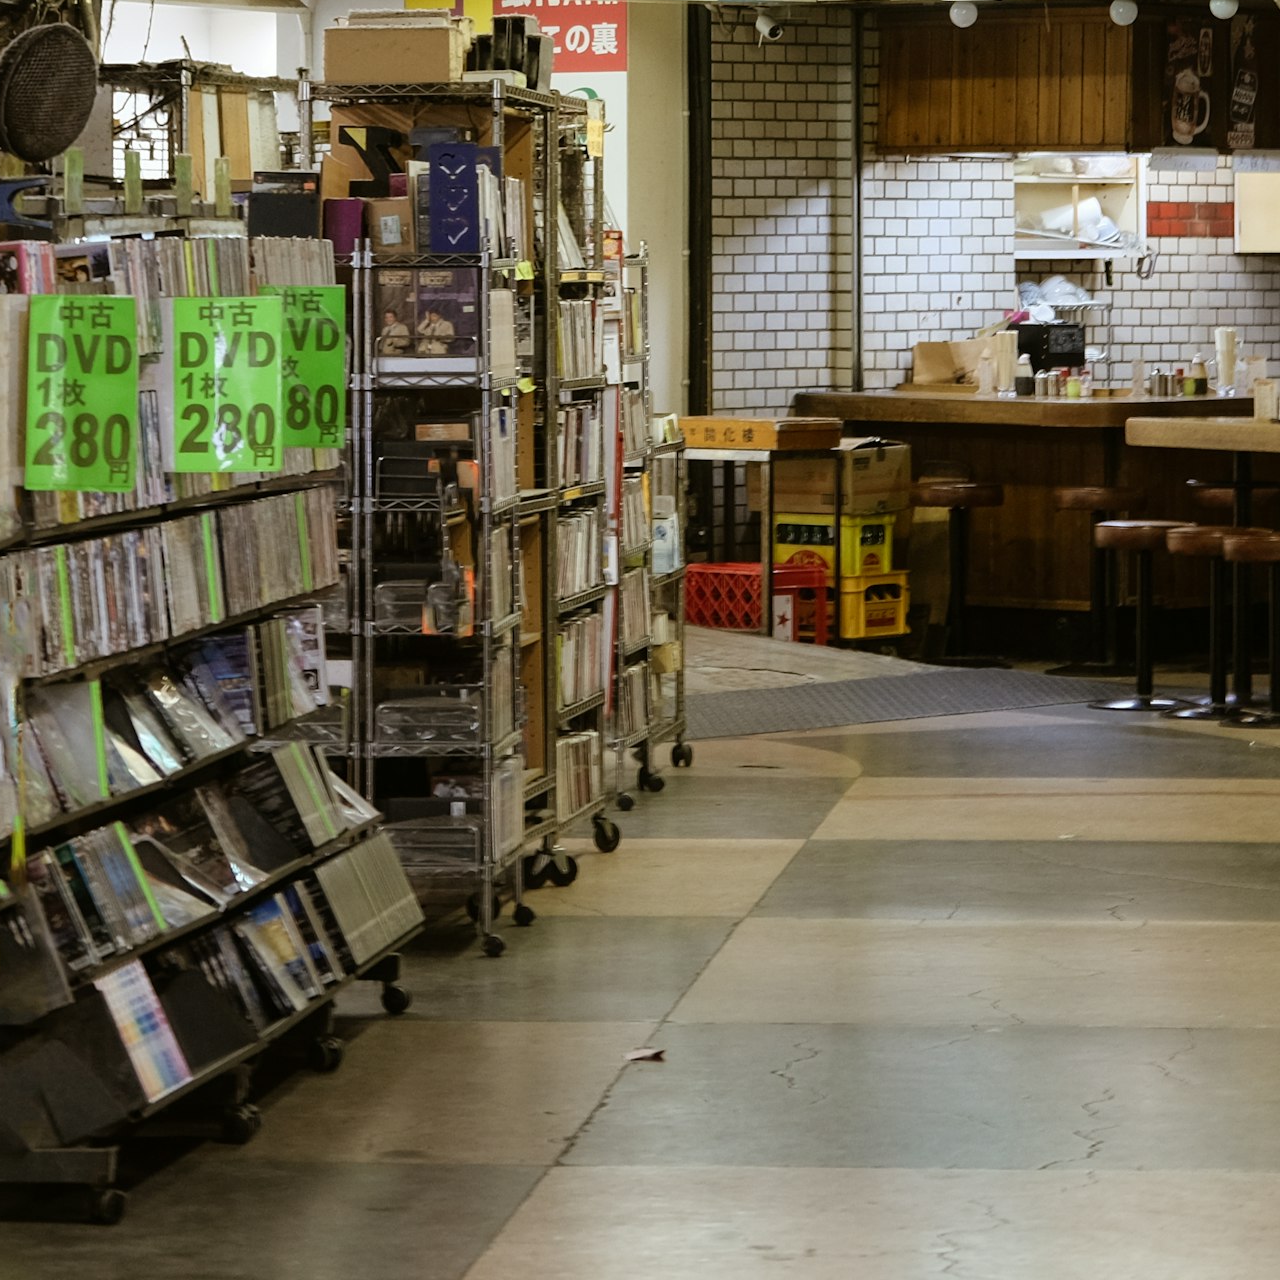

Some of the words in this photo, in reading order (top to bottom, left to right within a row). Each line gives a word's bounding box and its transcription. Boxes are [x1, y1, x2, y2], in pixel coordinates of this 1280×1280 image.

[60, 301, 114, 328] 中古
[199, 301, 257, 327] 中古
[286, 318, 340, 351] VD
[37, 333, 132, 374] DVD
[179, 331, 276, 368] DVD
[37, 378, 86, 407] 1枚
[181, 372, 228, 399] 1枚
